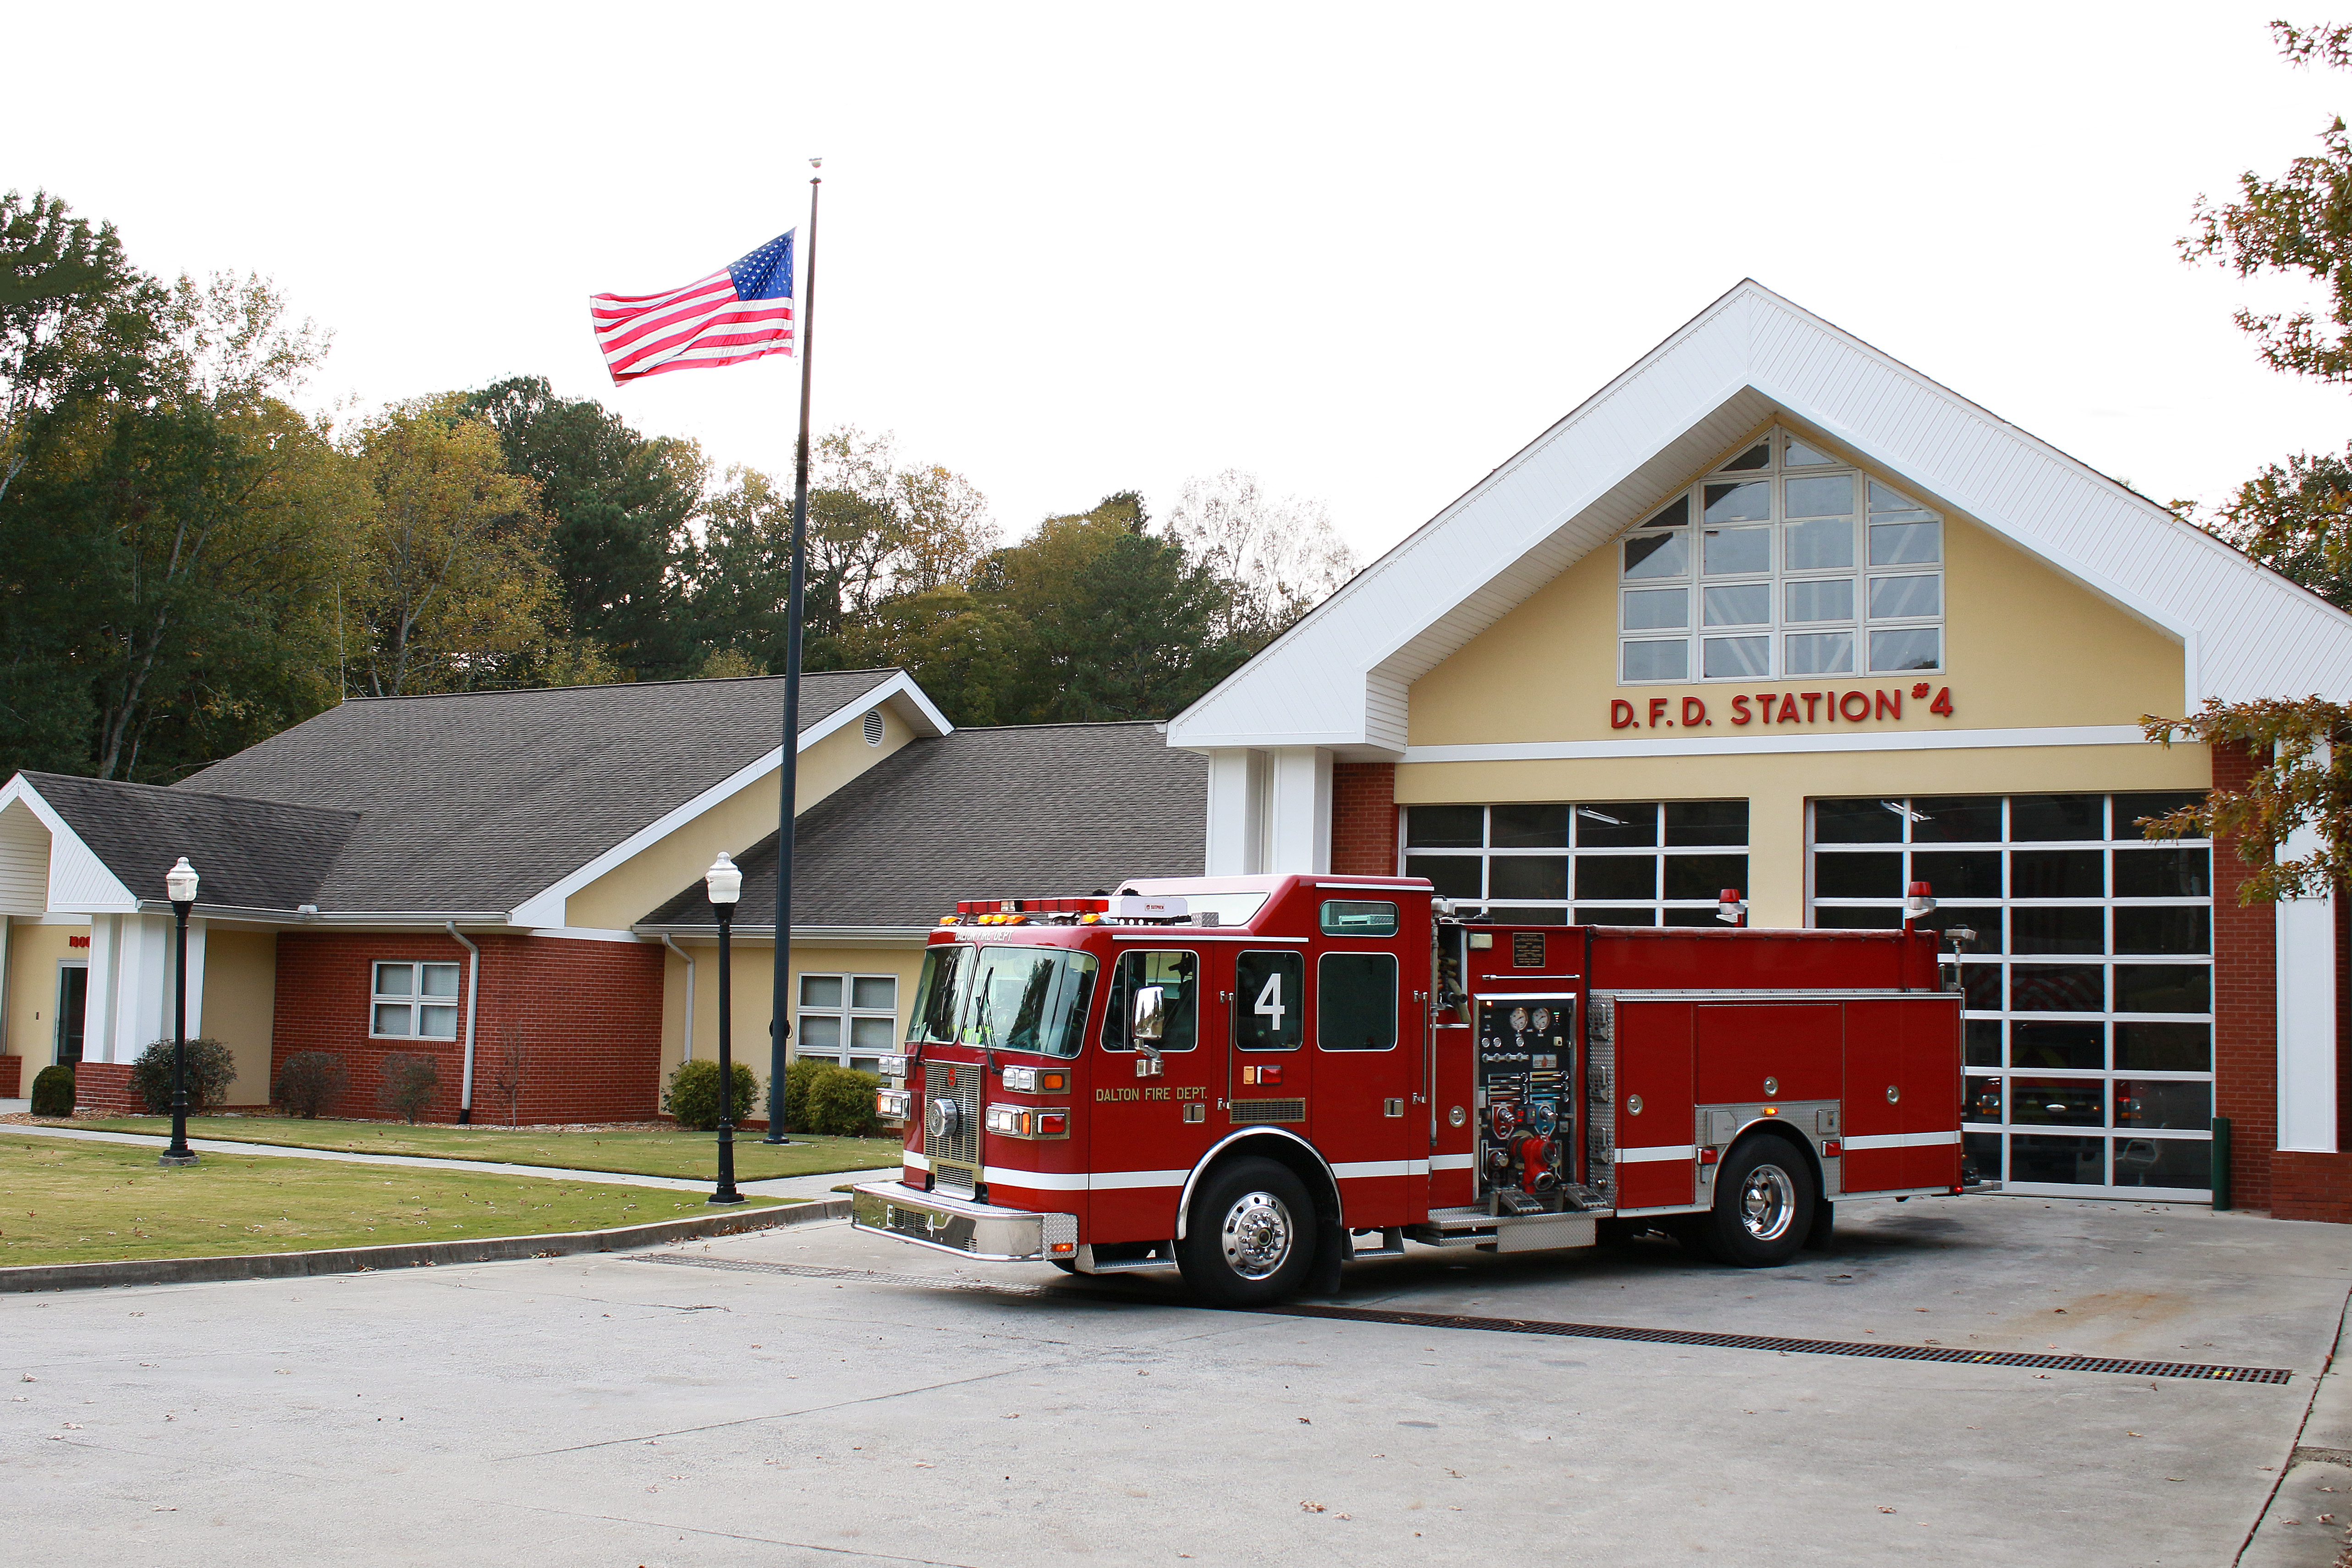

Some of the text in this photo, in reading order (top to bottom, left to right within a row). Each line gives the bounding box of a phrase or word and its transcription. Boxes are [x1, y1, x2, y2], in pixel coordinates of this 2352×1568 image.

[1610, 682, 1953, 728] D.F.D. STATION #4
[955, 930, 1015, 942] DALTON FIRE DEPT.
[1254, 973, 1285, 1031] 4
[1096, 1086, 1208, 1102] DALTON FIRE DEPT.
[887, 1204, 934, 1238] E 4
